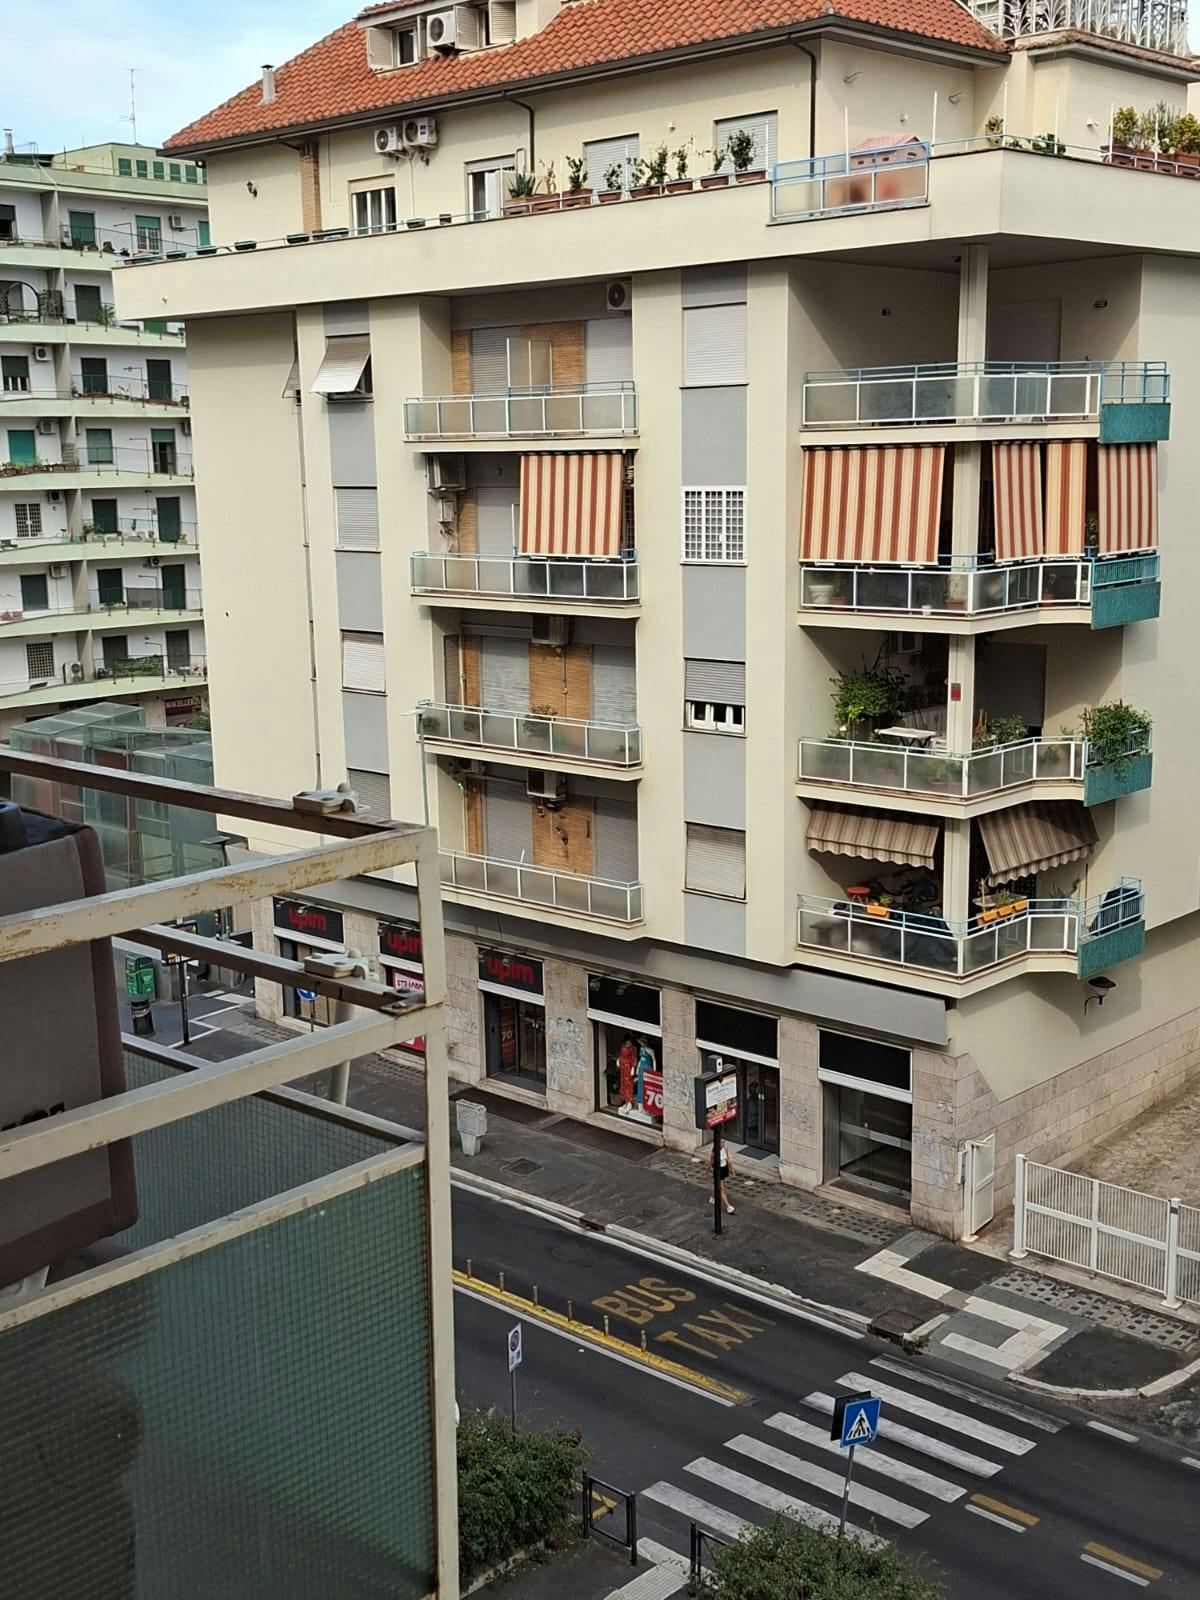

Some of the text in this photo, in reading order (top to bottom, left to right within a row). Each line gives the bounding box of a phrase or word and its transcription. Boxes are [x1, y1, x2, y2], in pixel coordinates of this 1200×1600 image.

[486, 955, 534, 986] upim
[591, 1276, 697, 1326] BUS
[653, 1302, 777, 1360] TAXI
